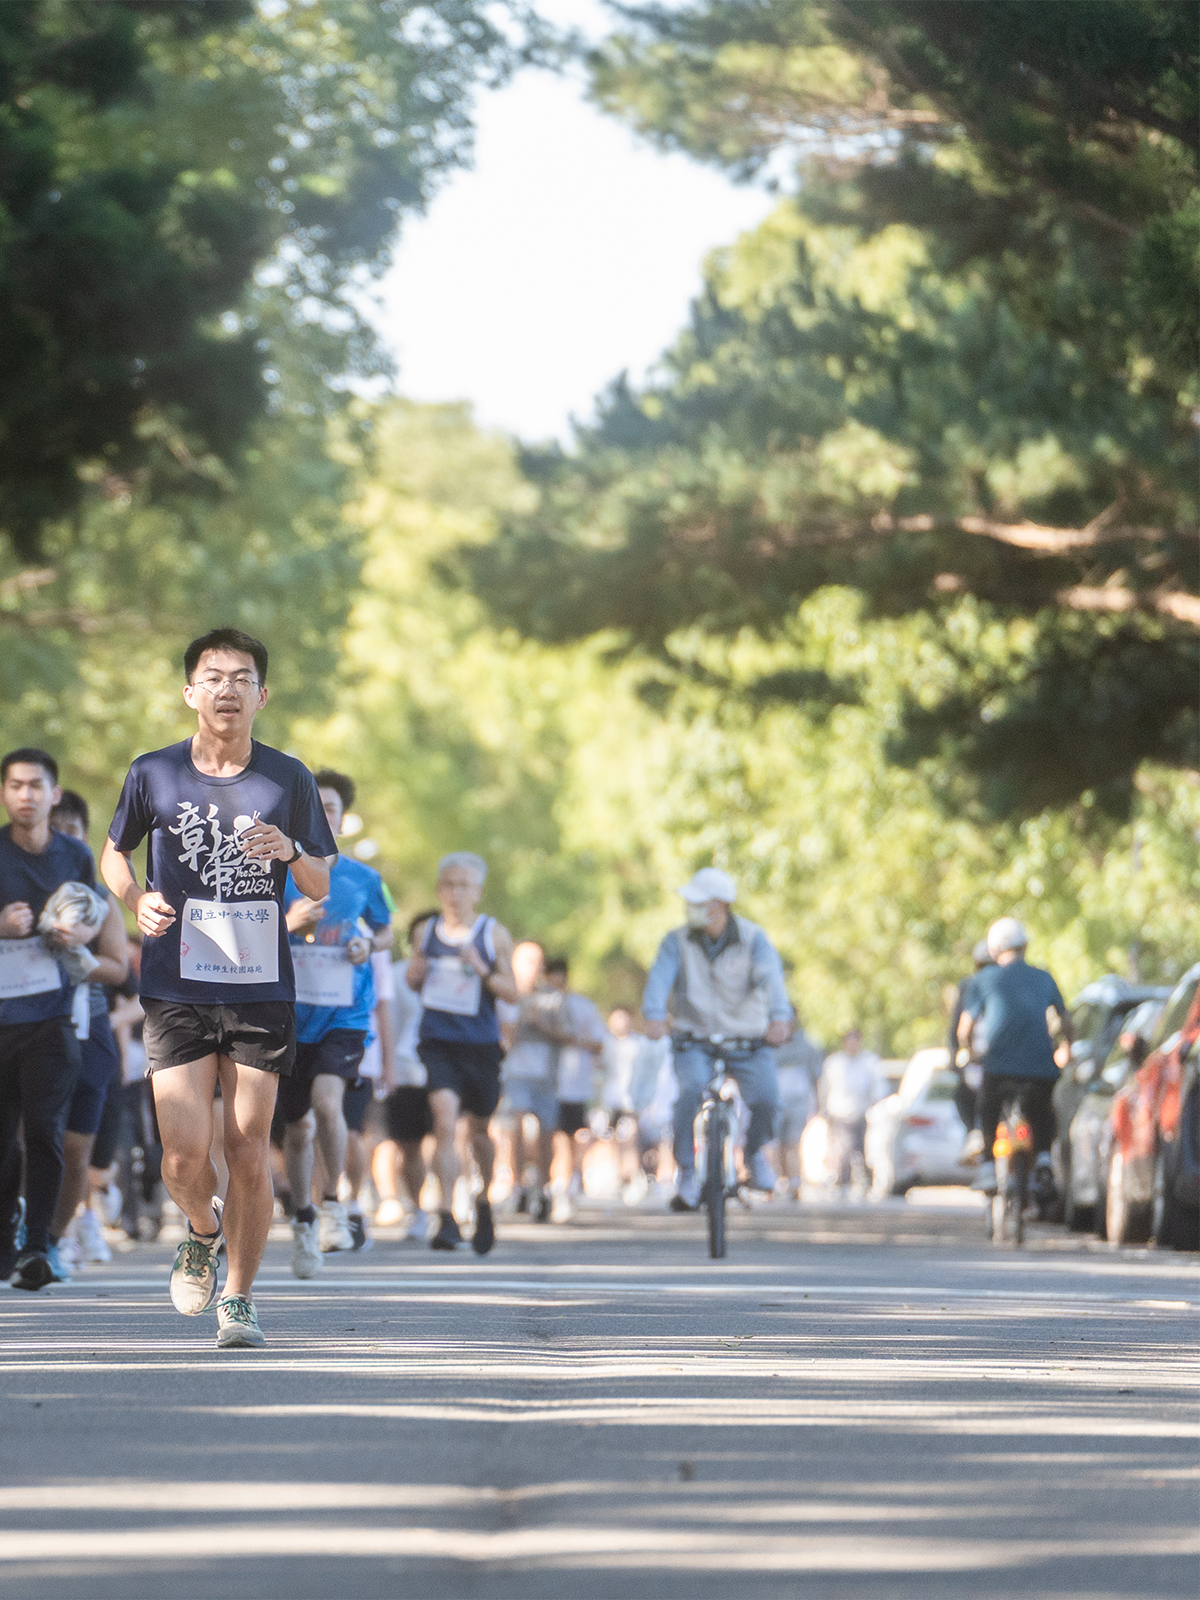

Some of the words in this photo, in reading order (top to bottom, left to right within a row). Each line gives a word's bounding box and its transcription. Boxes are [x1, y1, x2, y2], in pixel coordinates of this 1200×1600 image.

[233, 865, 248, 880] The
[221, 881, 234, 898] of
[190, 908, 270, 924] 國立中央大學
[195, 962, 263, 974] 全校師生校園路跑
